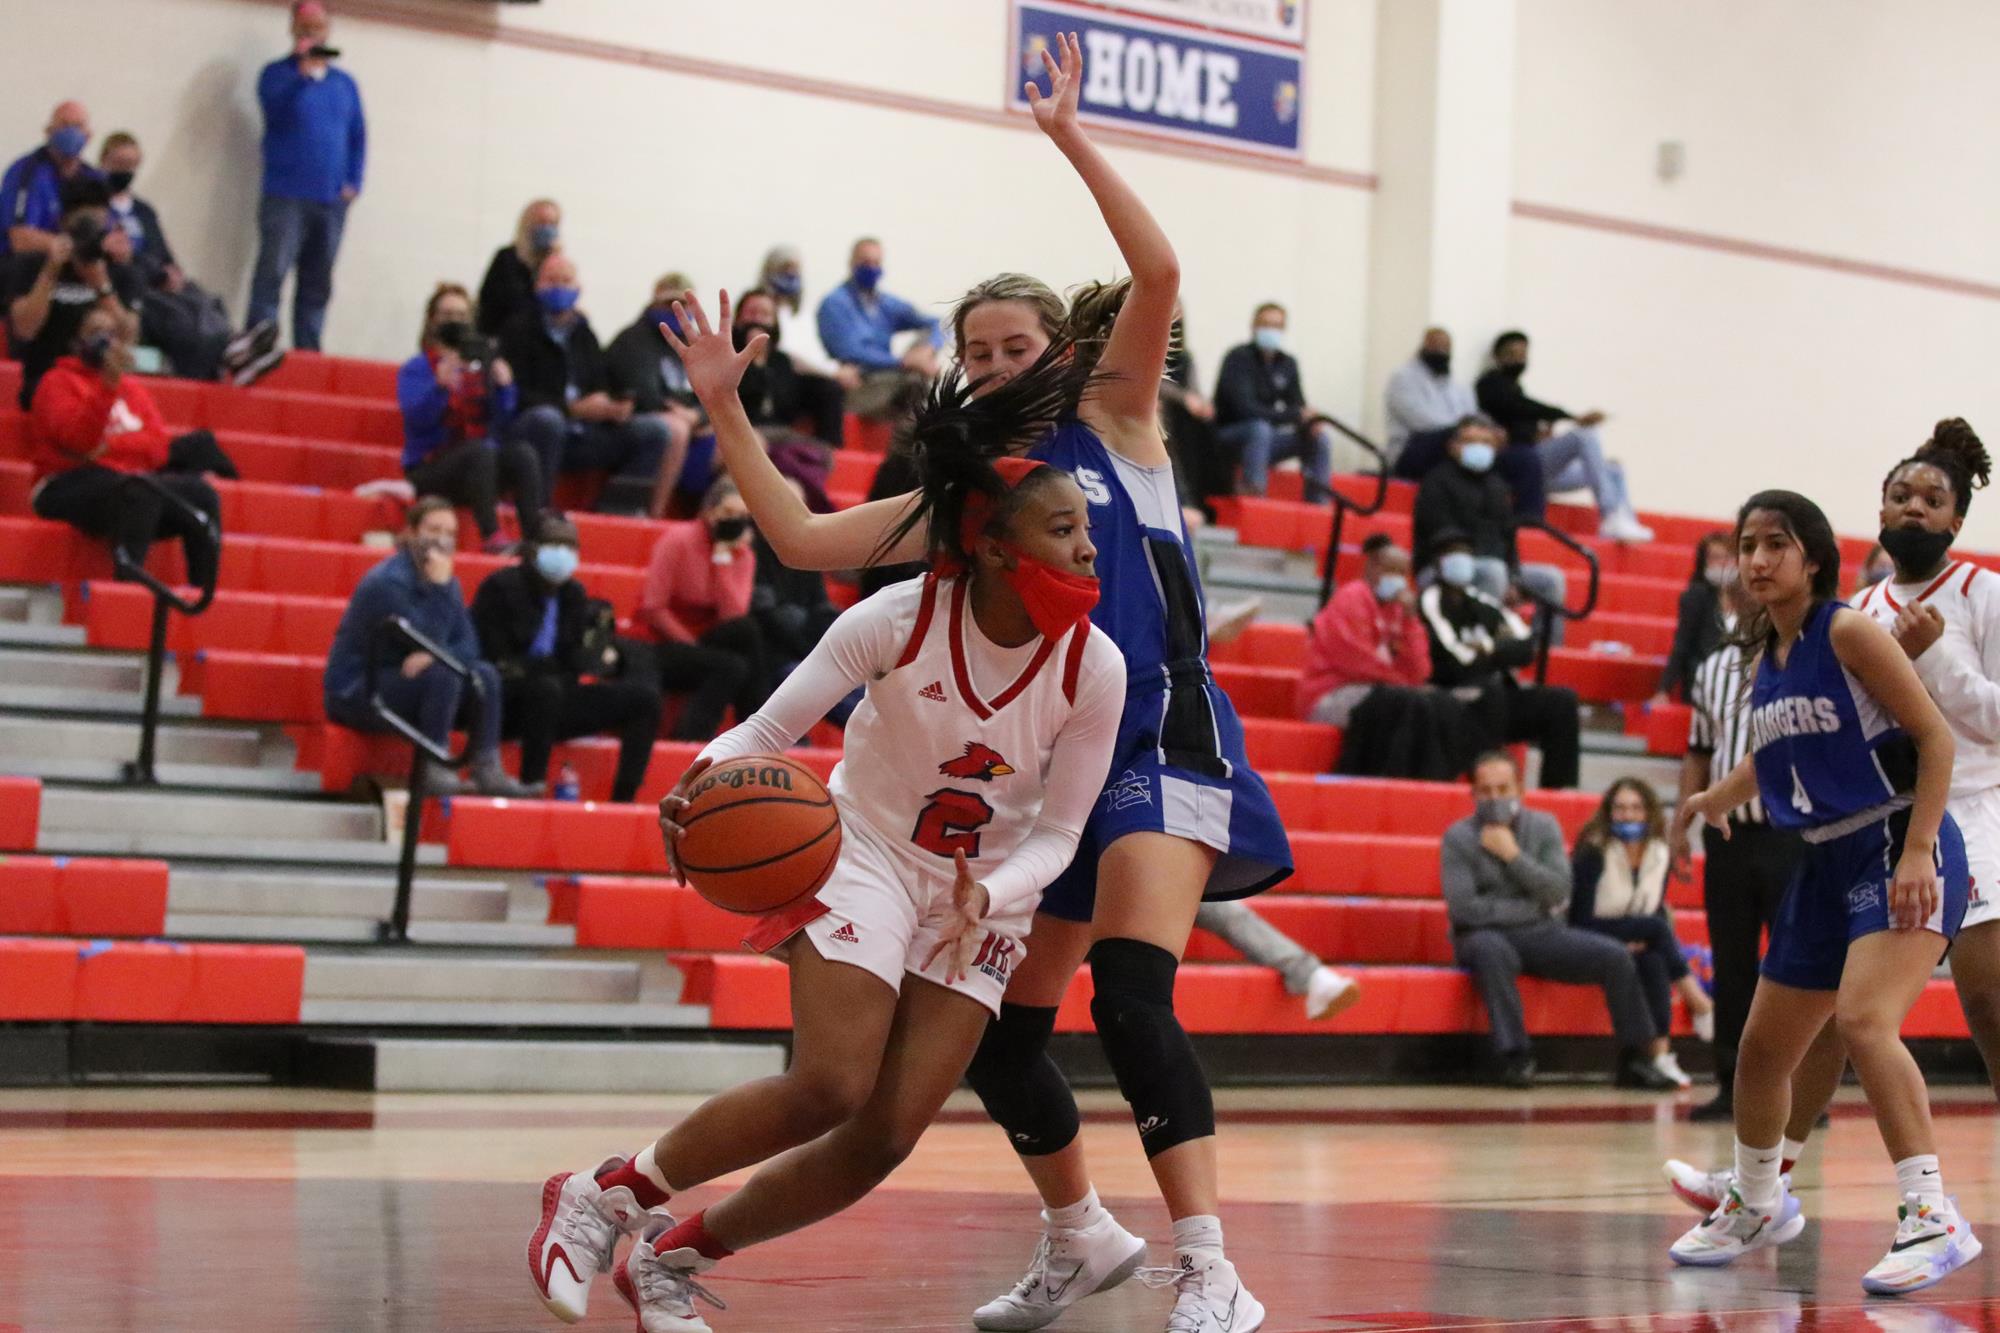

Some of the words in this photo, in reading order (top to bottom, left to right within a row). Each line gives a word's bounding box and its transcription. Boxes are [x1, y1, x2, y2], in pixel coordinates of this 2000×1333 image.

[1083, 29, 1239, 128] HOME
[918, 689, 947, 702] adidas
[687, 766, 792, 803] Wilson
[910, 787, 994, 859] 2
[830, 932, 859, 943] adidas
